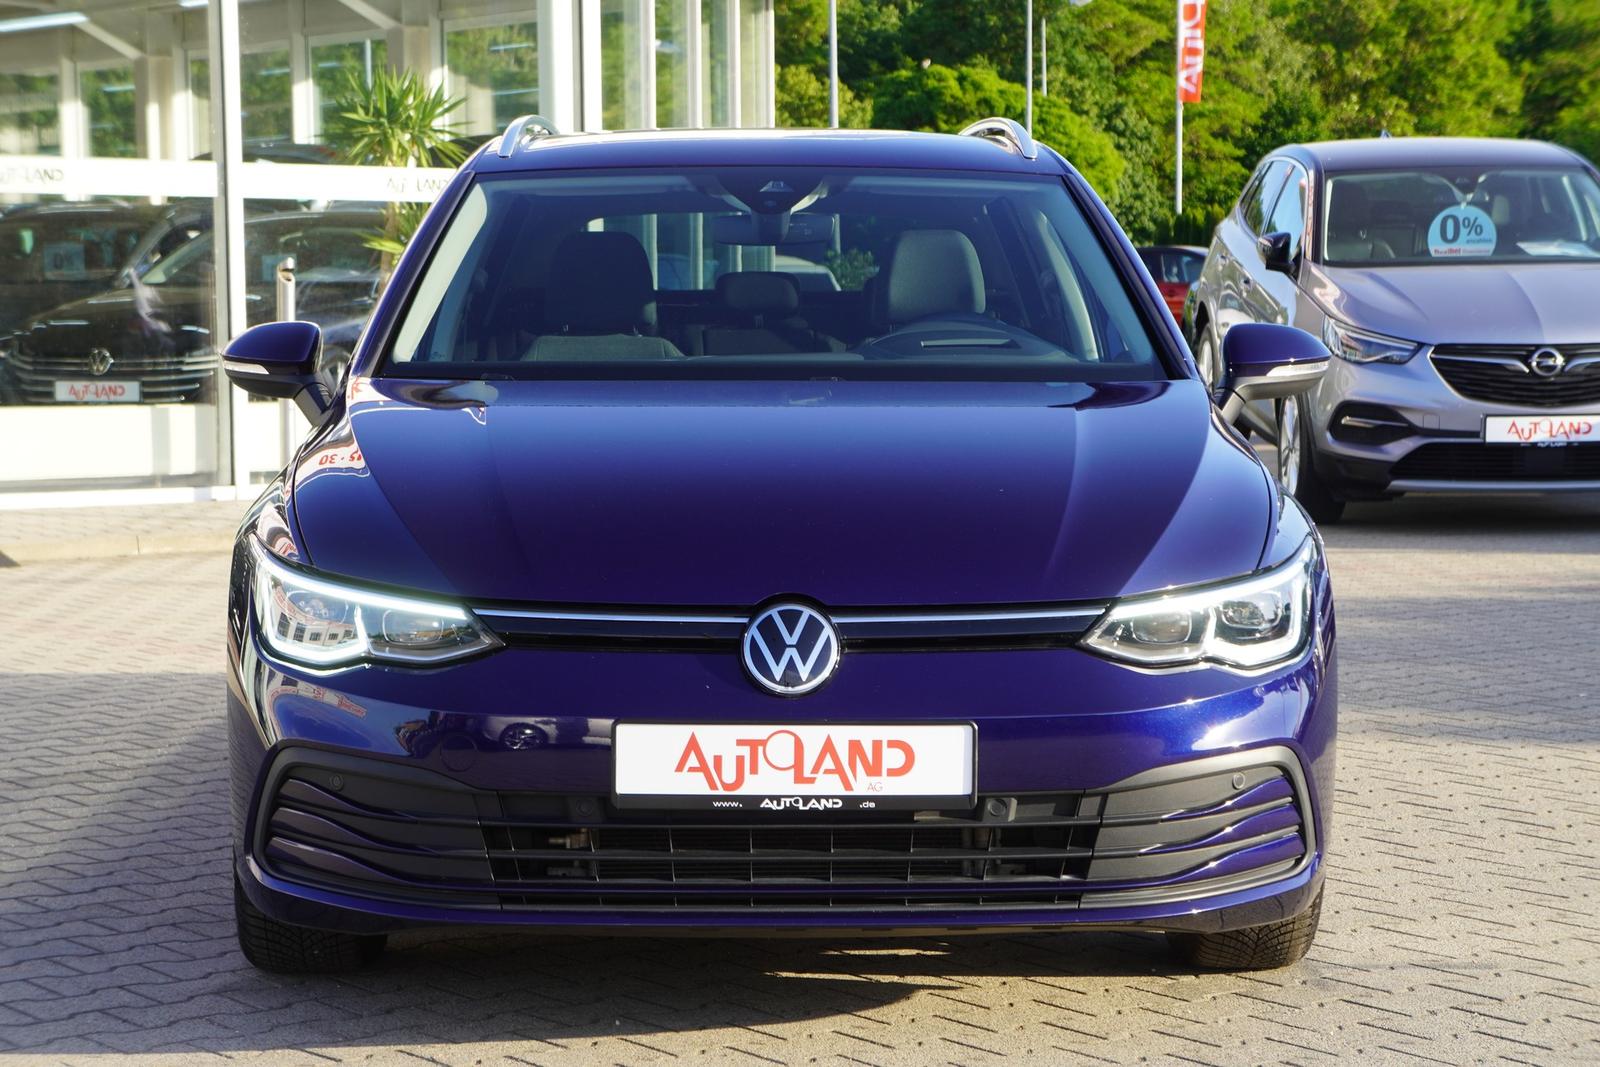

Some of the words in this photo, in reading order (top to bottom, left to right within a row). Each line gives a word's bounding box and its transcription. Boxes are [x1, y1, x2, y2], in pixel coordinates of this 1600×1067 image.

[1507, 417, 1593, 440] AUTOLAND
[674, 729, 916, 792] AUTOLAND
[867, 781, 883, 792] AG
[760, 796, 843, 811] AUTOLAND
